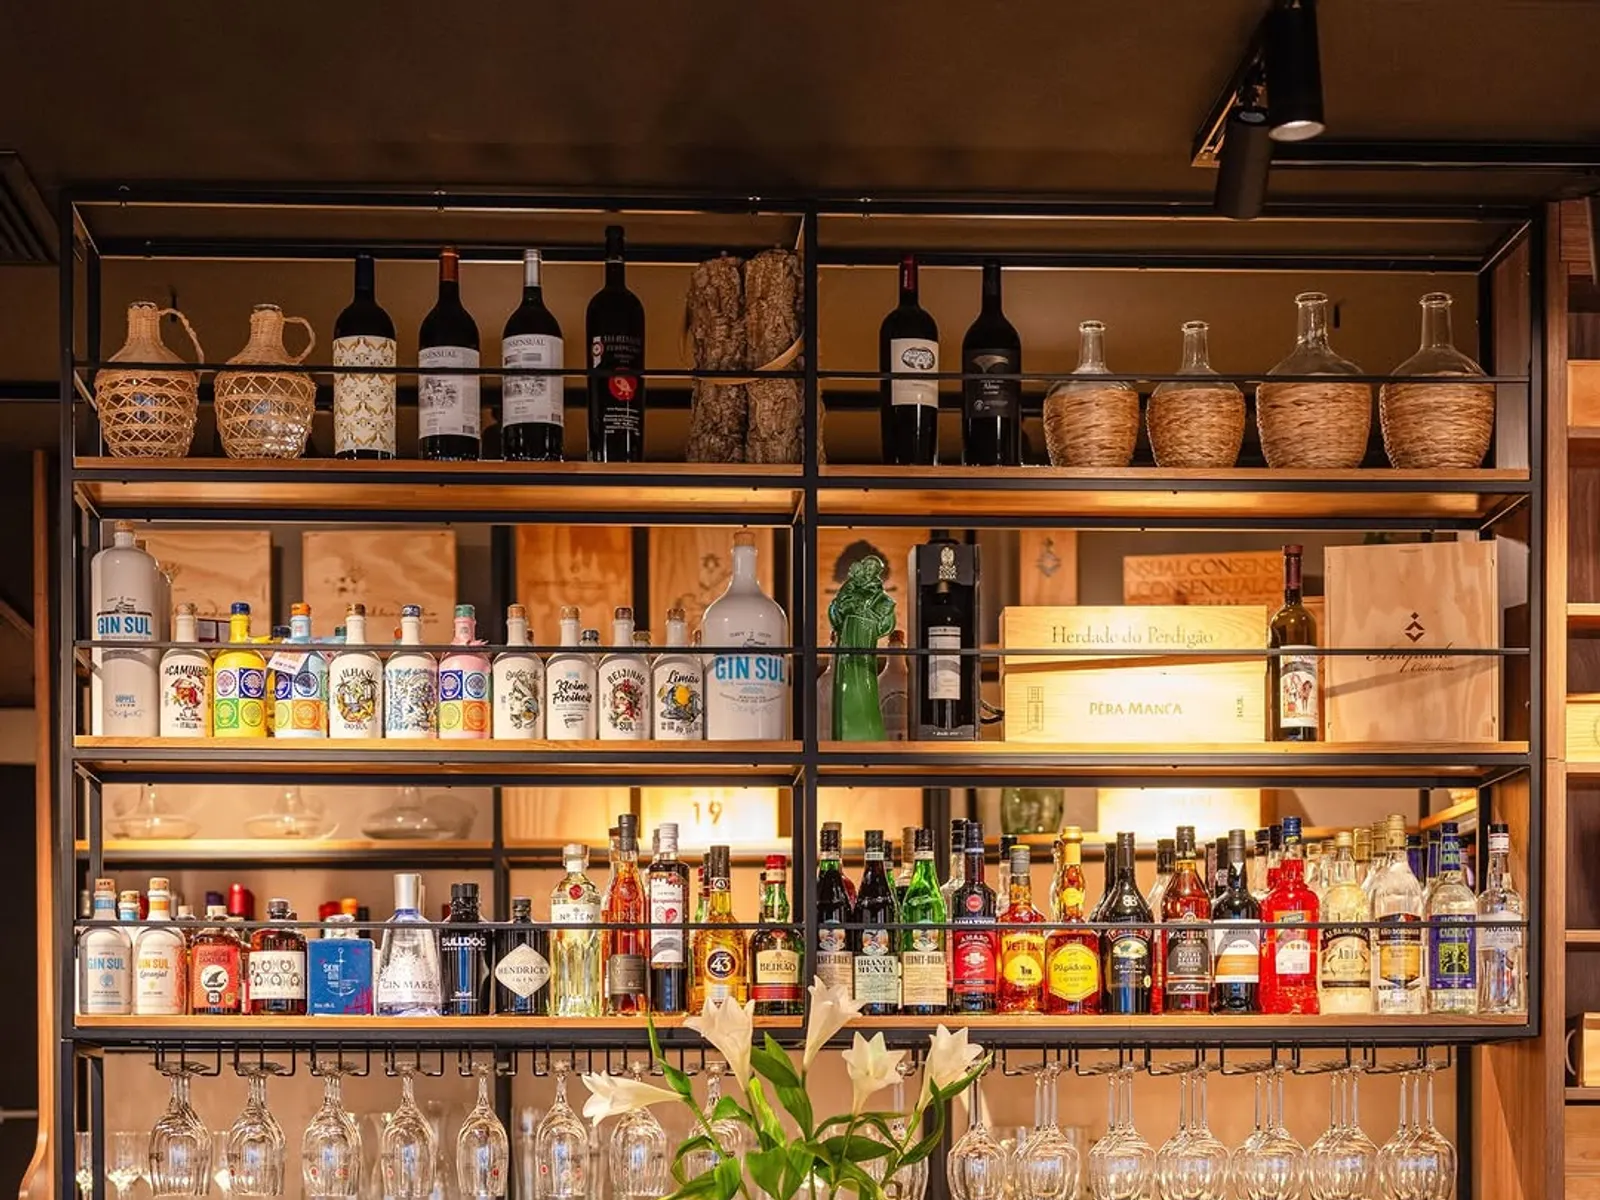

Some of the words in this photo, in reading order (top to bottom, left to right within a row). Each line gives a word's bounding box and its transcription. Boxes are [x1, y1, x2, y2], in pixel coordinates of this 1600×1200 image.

[98, 616, 121, 634] GIN
[124, 617, 152, 635] SUL
[1052, 626, 1118, 643] Herdade
[1121, 626, 1142, 643] do
[1147, 626, 1213, 648] Perdigão
[715, 656, 750, 680] GIN
[755, 656, 784, 682] SUL
[607, 668, 646, 685] BEIJINHO
[441, 936, 488, 947] BULLDOG
[107, 958, 126, 970] SUL
[153, 958, 170, 970] SUL
[710, 957, 731, 972] 43
[857, 958, 894, 967] BRANCA
[858, 966, 894, 974] MENTA
[381, 980, 401, 990] GIN
[403, 980, 434, 990] MARE
